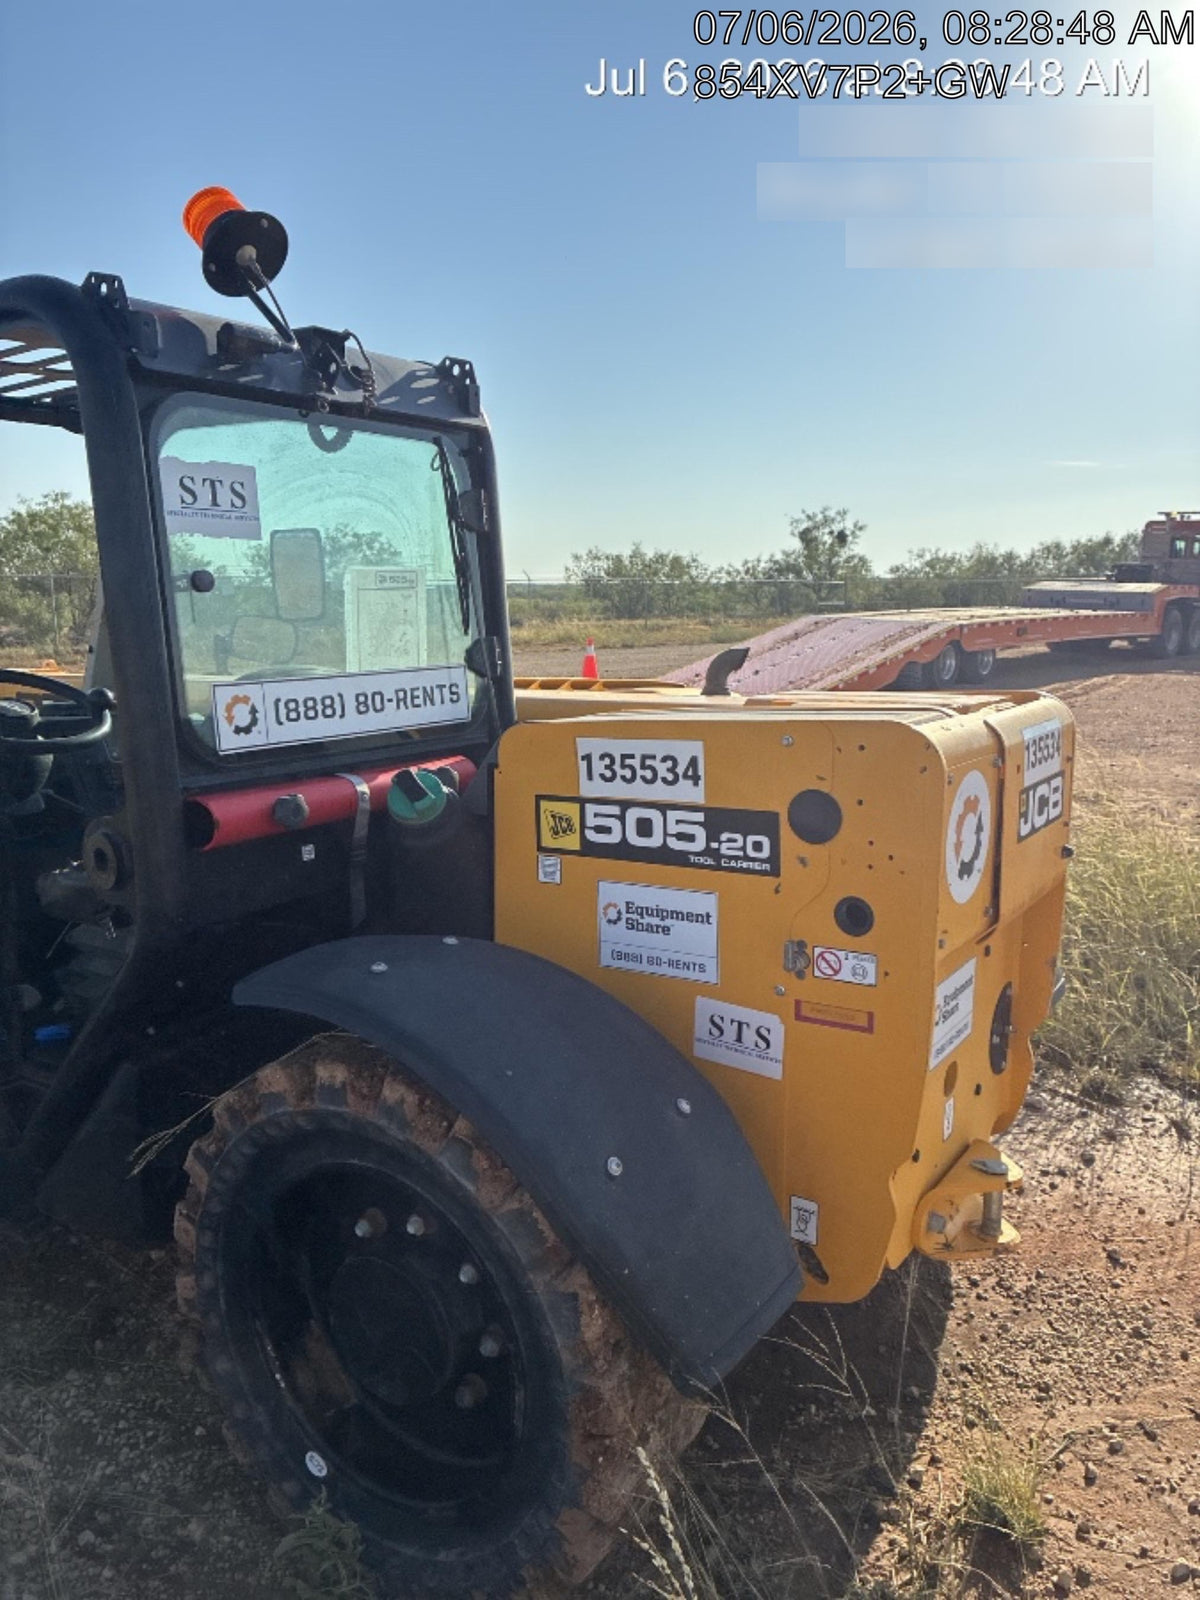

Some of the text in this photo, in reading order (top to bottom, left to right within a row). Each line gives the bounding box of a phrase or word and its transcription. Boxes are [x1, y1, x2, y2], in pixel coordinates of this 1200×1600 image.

[178, 474, 247, 510] STS
[274, 682, 461, 726] (888) 80-RENTS
[1024, 727, 1061, 771] 135534
[580, 752, 702, 787] 135534
[1019, 776, 1063, 836] JCB
[548, 811, 576, 837] JCB
[688, 854, 716, 866] TOOL
[625, 900, 713, 926] Equipment
[625, 917, 671, 936] Share
[708, 1013, 771, 1052] STS
